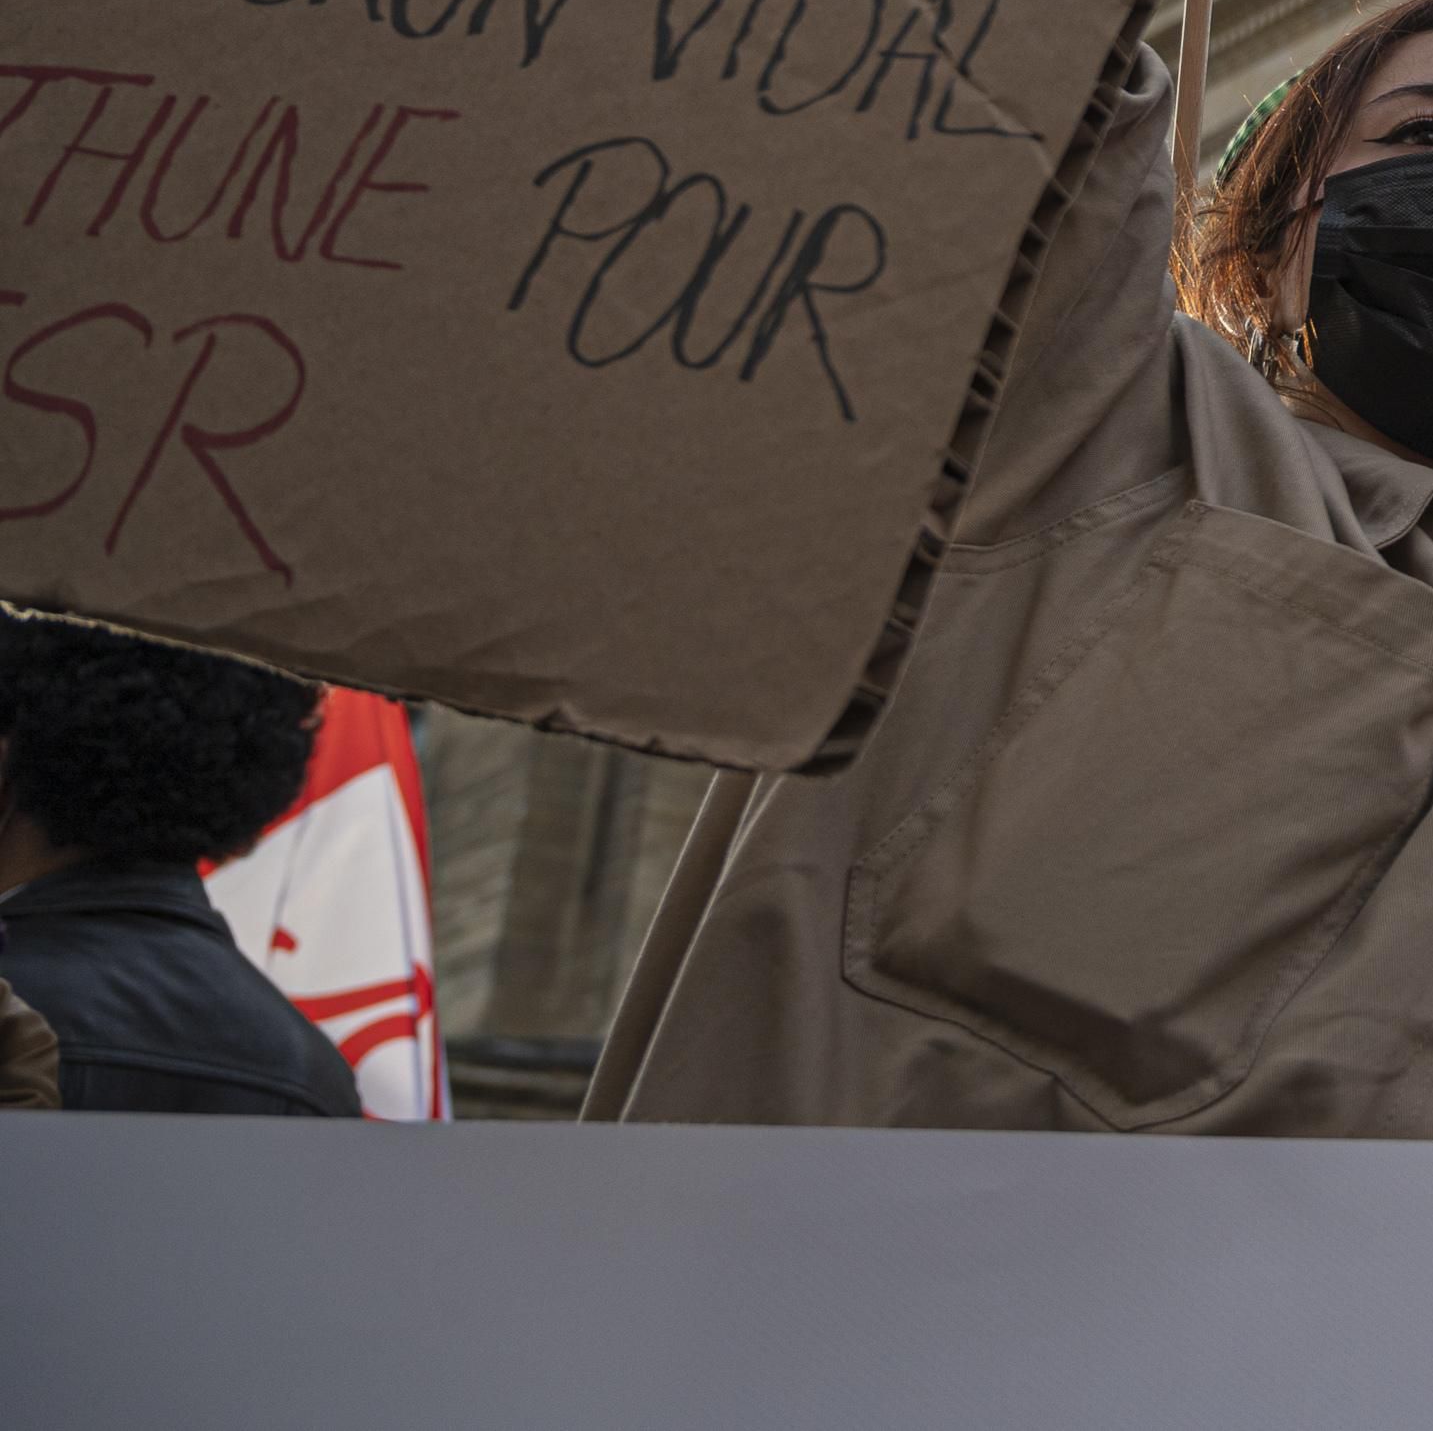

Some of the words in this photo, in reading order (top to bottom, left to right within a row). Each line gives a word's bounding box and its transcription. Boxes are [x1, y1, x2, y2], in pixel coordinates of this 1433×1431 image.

[0, 63, 461, 270] THUNE
[508, 137, 887, 423] POUR
[0, 290, 304, 588] SR
